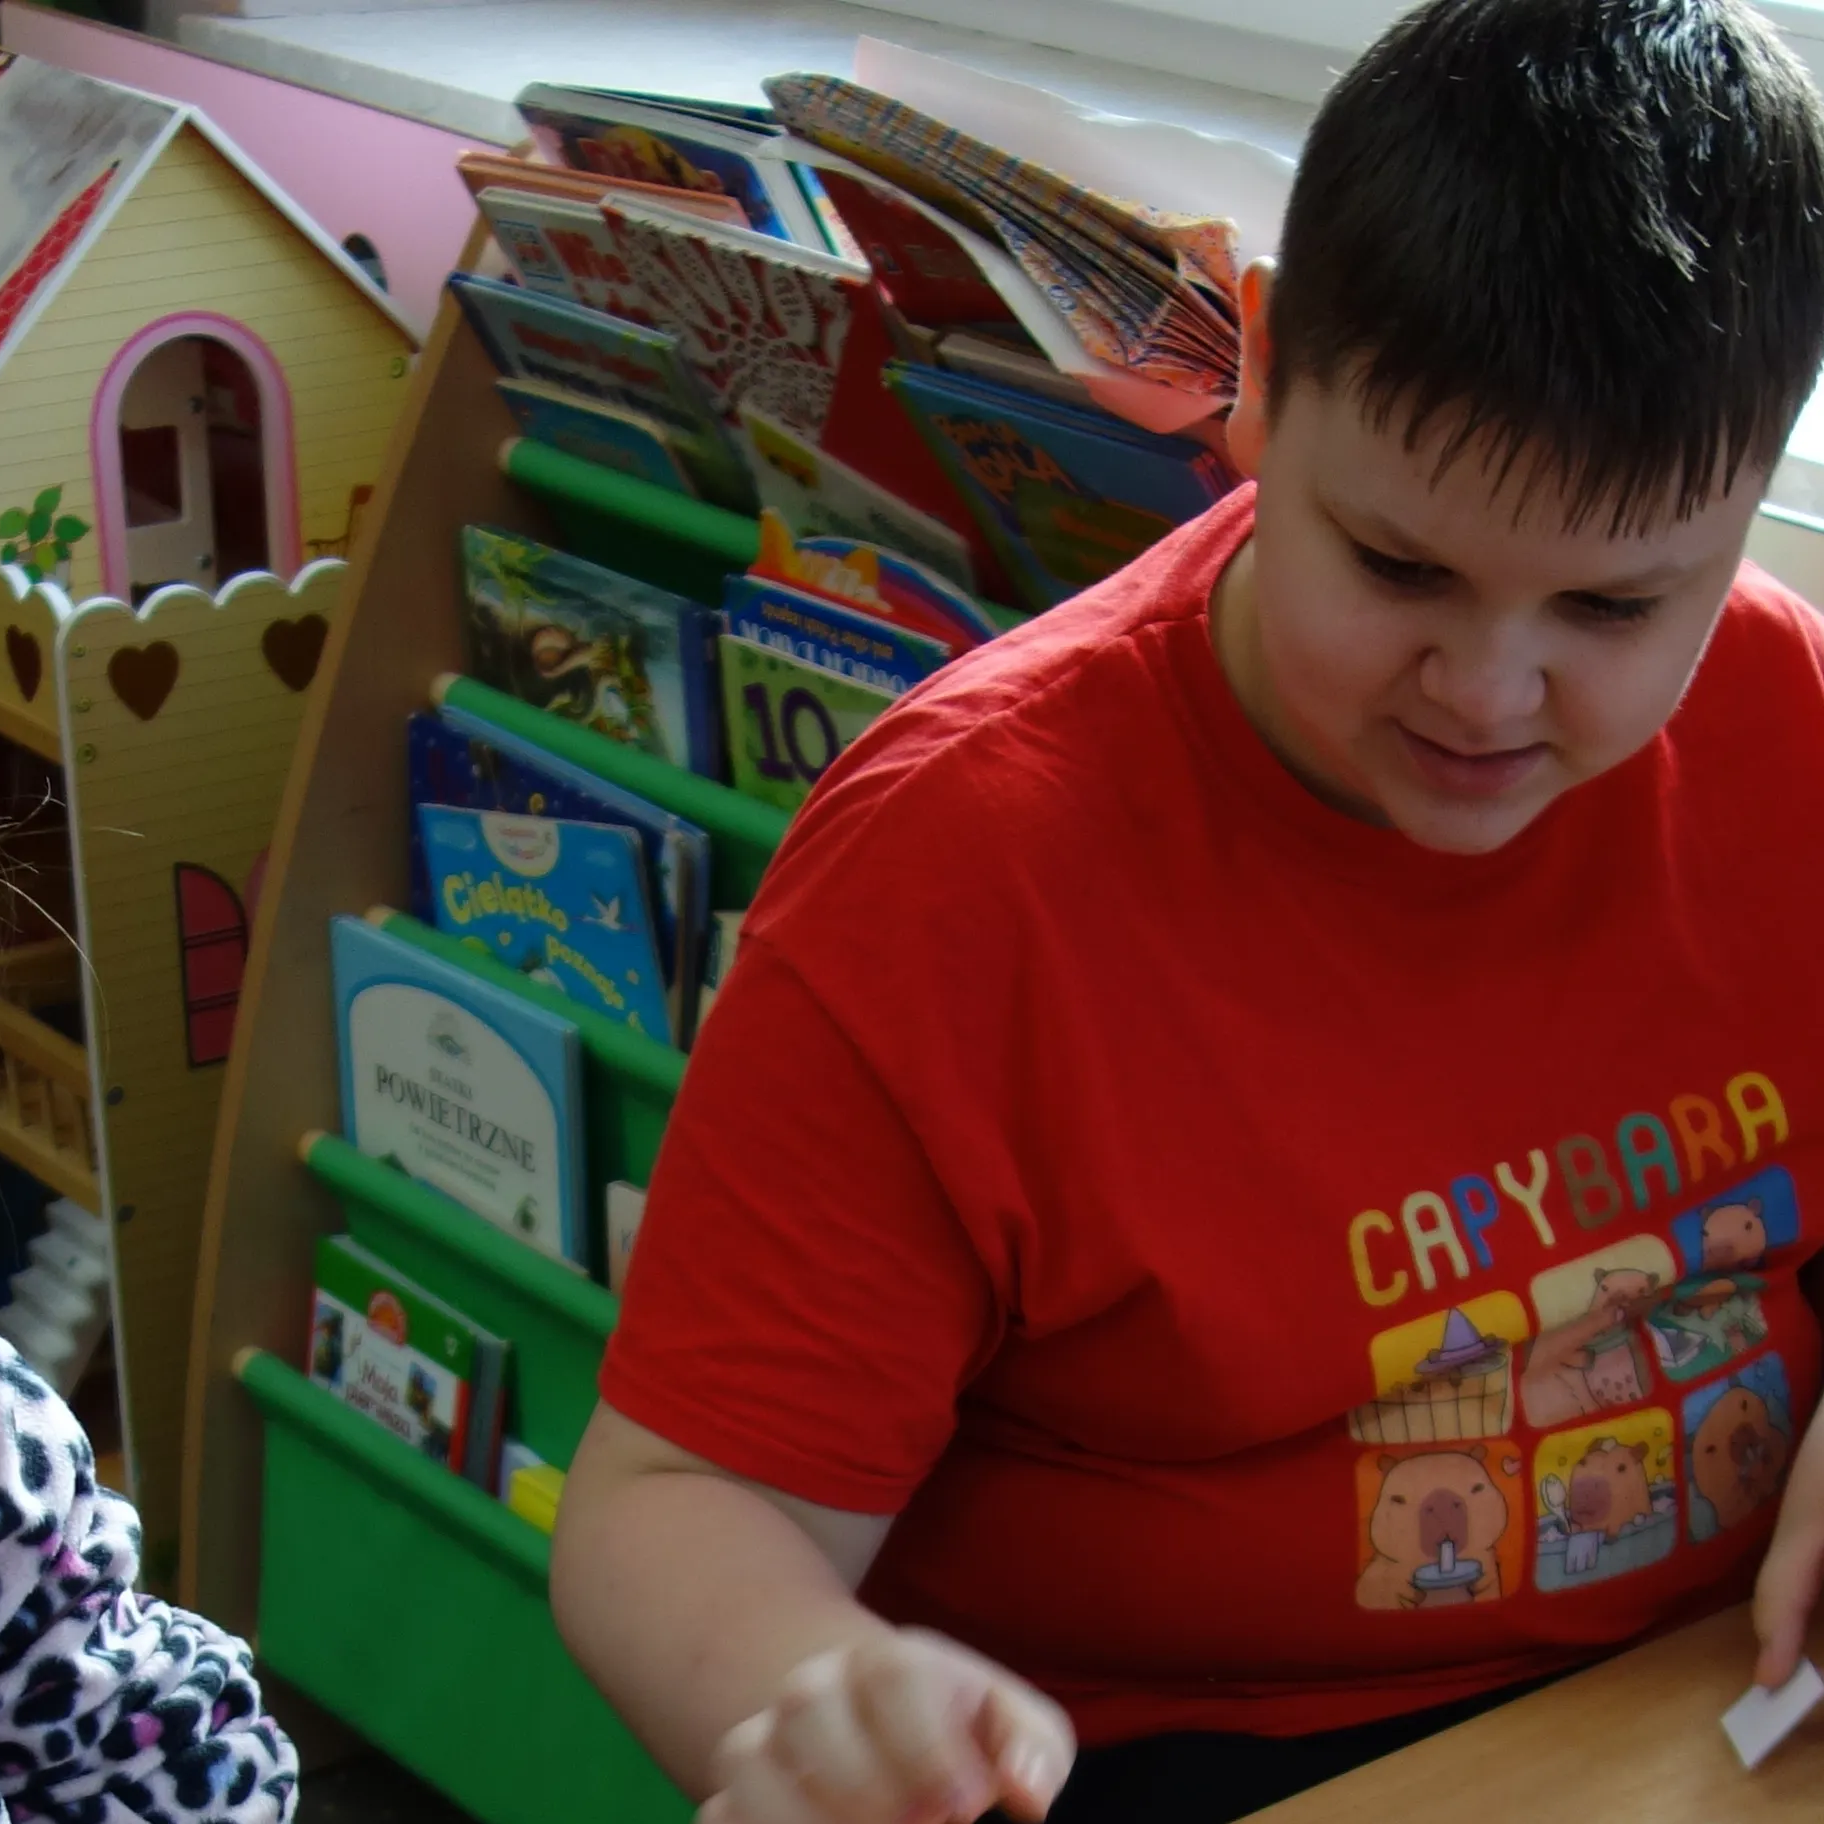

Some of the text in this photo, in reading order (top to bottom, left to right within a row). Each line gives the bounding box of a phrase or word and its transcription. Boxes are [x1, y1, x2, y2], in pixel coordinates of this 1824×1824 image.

[744, 682, 841, 784] 10
[375, 1062, 537, 1174] POWIETRZNE
[1348, 1071, 1790, 1306] CAPYBARA
